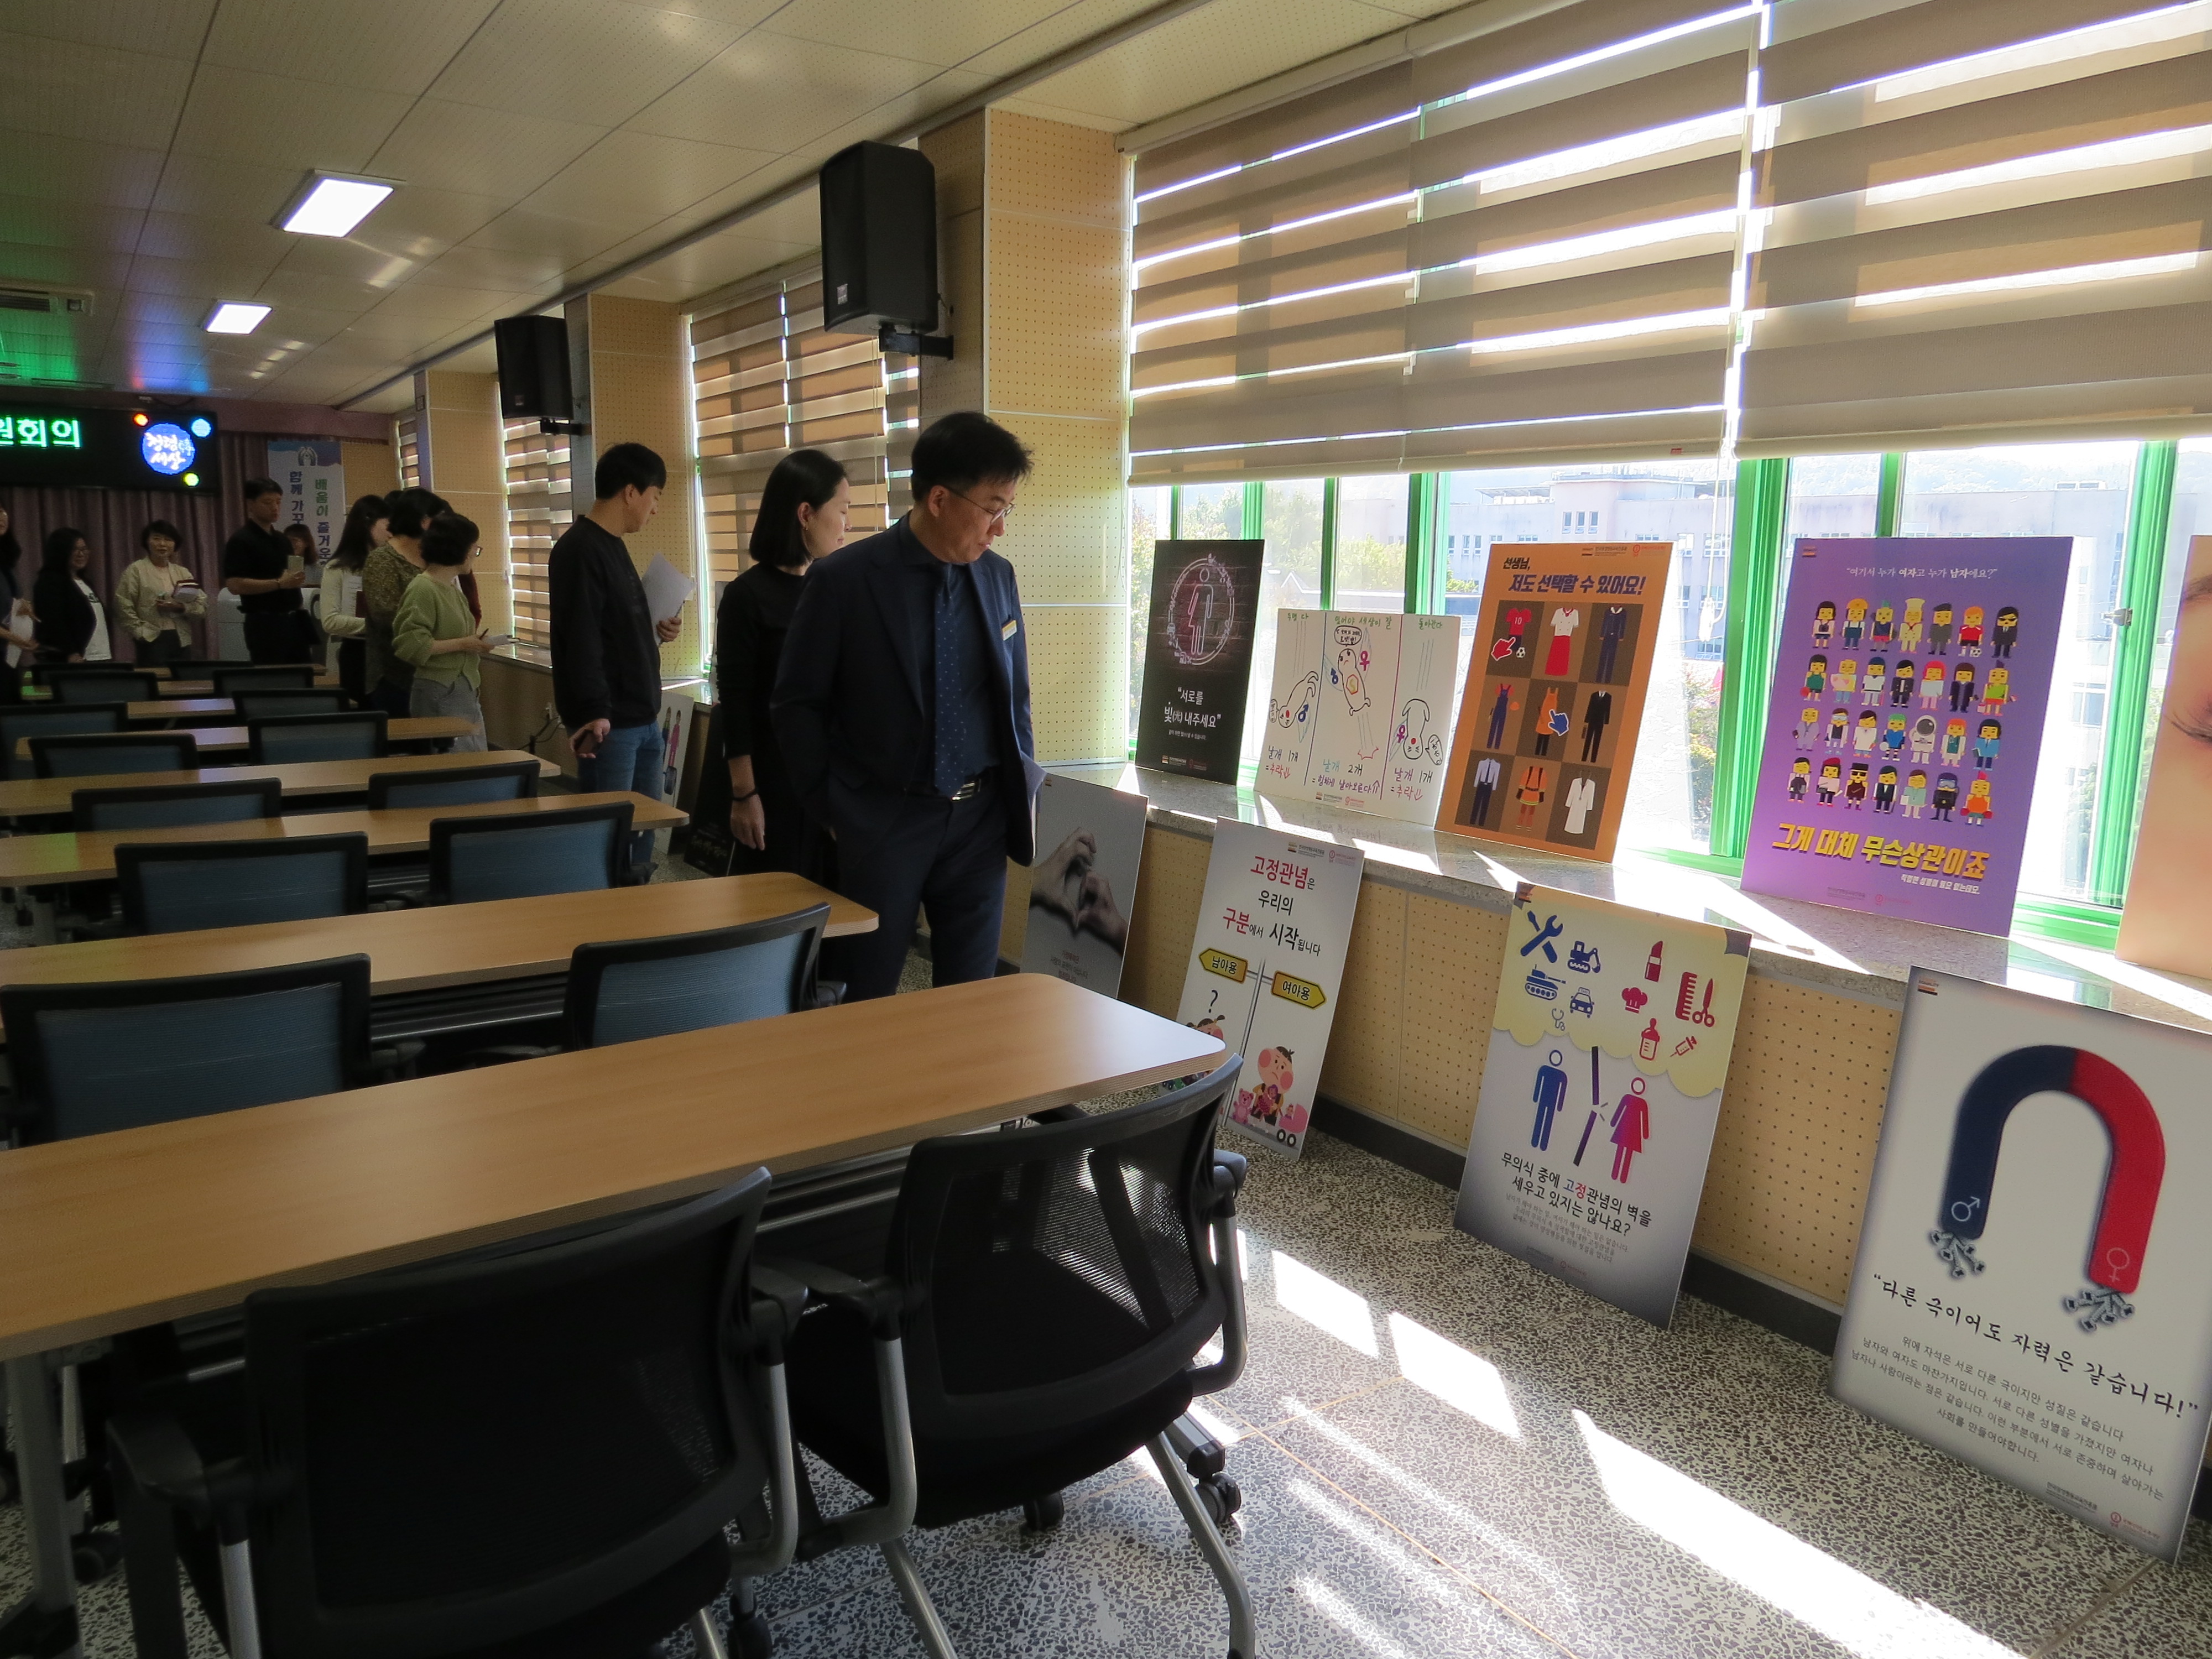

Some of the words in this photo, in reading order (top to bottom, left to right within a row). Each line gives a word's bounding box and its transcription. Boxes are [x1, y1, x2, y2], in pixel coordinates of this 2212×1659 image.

[150, 451, 186, 471] 세상
[290, 471, 304, 495] 함께
[315, 479, 328, 517] 배움이
[1503, 557, 1531, 571] 선생님,
[1877, 567, 1896, 577] 누가
[1898, 567, 1926, 577] 여자고
[1928, 568, 1947, 578] 누가
[1508, 574, 1537, 592] 저도
[1537, 574, 1579, 593] 선택할
[1579, 575, 1595, 593] 수
[1596, 575, 1647, 596] 있어요!
[1335, 615, 1355, 625] 있어야
[1359, 617, 1381, 627] 세상이
[1385, 616, 1392, 630] 잘
[1515, 617, 1522, 625] 10
[1268, 745, 1282, 760] 날개
[1323, 759, 1340, 773] 날개
[1348, 764, 1363, 776] 2개
[1395, 768, 1413, 782] 날개
[1772, 822, 1815, 853] 그게
[1815, 829, 1860, 859] 대체
[1861, 835, 1991, 880] 무슨상관이죠
[1250, 856, 1316, 890] 고정관념은
[1258, 890, 1293, 916] 우리의
[1223, 907, 1264, 938] 구분에서
[1269, 923, 1321, 956] 시작됩니다
[1212, 956, 1238, 975] 남아용
[1208, 989, 1218, 1013] ?
[1282, 980, 1311, 1001] 여아용
[1501, 1152, 1534, 1177] 무의식
[1537, 1167, 1561, 1188] 중에
[1563, 1178, 1623, 1215] 고정관념의
[1627, 1204, 1652, 1228] 벽을
[1512, 1176, 1545, 1199] 세우고
[1549, 1191, 1583, 1218] 있지는
[1587, 1207, 1631, 1237] 않나요?
[1873, 1273, 1917, 1307] “다른
[1926, 1298, 2001, 1342] 극이어도
[2011, 1333, 2074, 1373] 자력은
[1902, 1336, 1921, 1352] 위에
[1923, 1345, 1952, 1366] 자석은
[1954, 1360, 1974, 1375] 서로
[1977, 1370, 1997, 1386] 다른
[2000, 1379, 2042, 1406] 극이지만
[2045, 1399, 2077, 1421] 성질은
[2080, 1414, 2124, 1442] 같습니다
[1863, 1337, 1889, 1356] 남자와
[1892, 1351, 1919, 1370] 여자도
[1922, 1364, 1989, 1401] 마찬가지입니다.
[1992, 1396, 2012, 1411] 서로
[2016, 1406, 2036, 1422] 다른
[2039, 1417, 2070, 1439] 성별을
[2074, 1433, 2117, 1459] 가졌지만
[2120, 1453, 2154, 1476] 여자나
[1937, 1408, 1965, 1428] 사회를
[1851, 1349, 1877, 1368] 남자나
[1879, 1363, 1923, 1390] 사람이라는
[1925, 1384, 1943, 1399] 점은
[1946, 1392, 1985, 1417] 같습니다.
[1987, 1412, 2007, 1428] 이런
[2010, 1422, 2049, 1448] 부분에서
[2052, 1442, 2073, 1458] 서로
[2075, 1452, 2117, 1479] 존중하며
[2121, 1473, 2164, 1501] 살아가는
